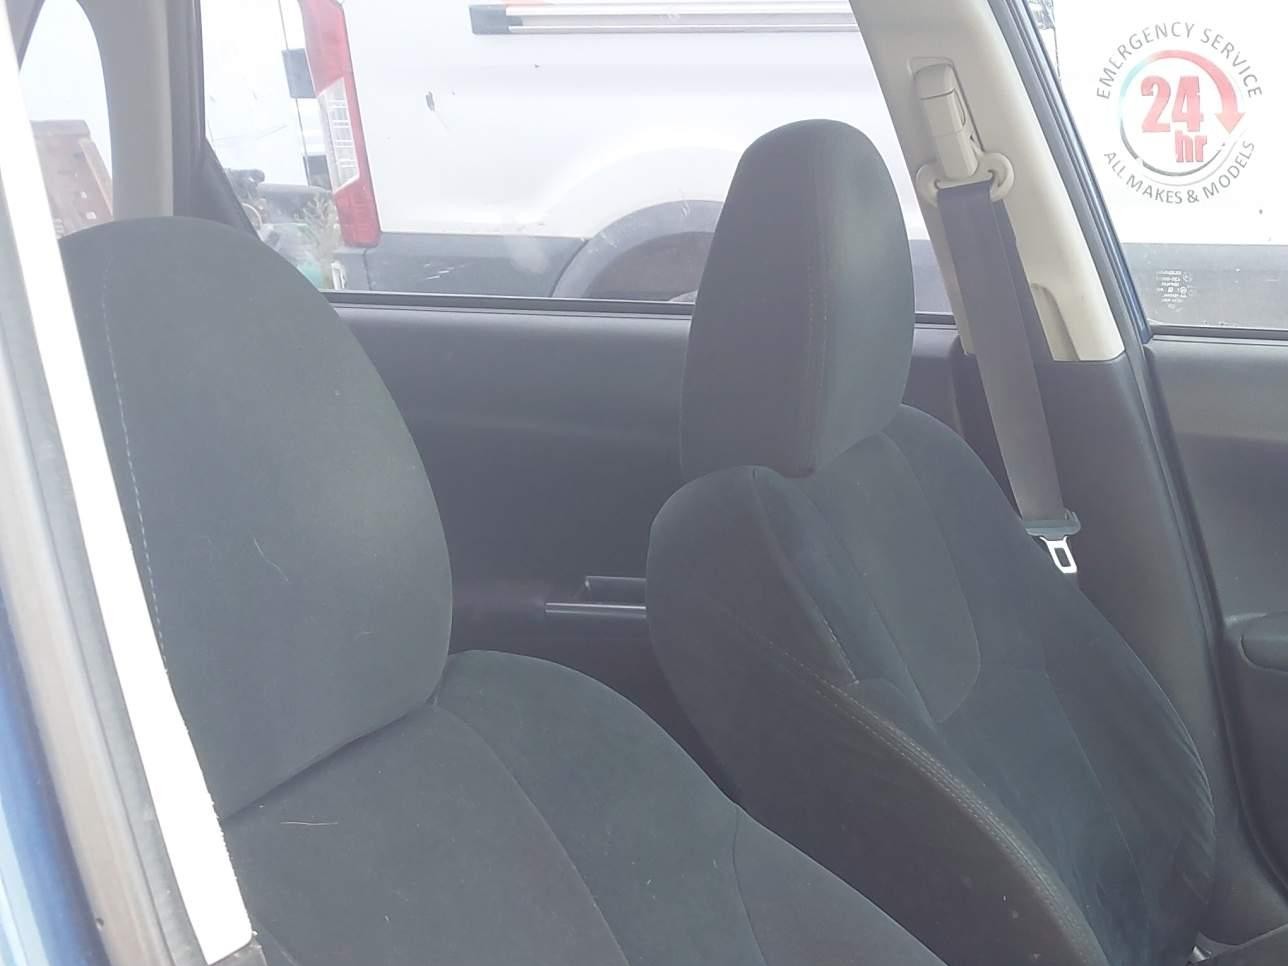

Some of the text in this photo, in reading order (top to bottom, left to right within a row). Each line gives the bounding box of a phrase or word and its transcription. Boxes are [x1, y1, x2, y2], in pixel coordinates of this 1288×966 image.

[1096, 21, 1263, 100] EMERGENCY SERVICE
[1140, 75, 1204, 133] 24
[1103, 140, 1255, 204] ALL MAKES & MODELS
[1174, 129, 1208, 163] hr
